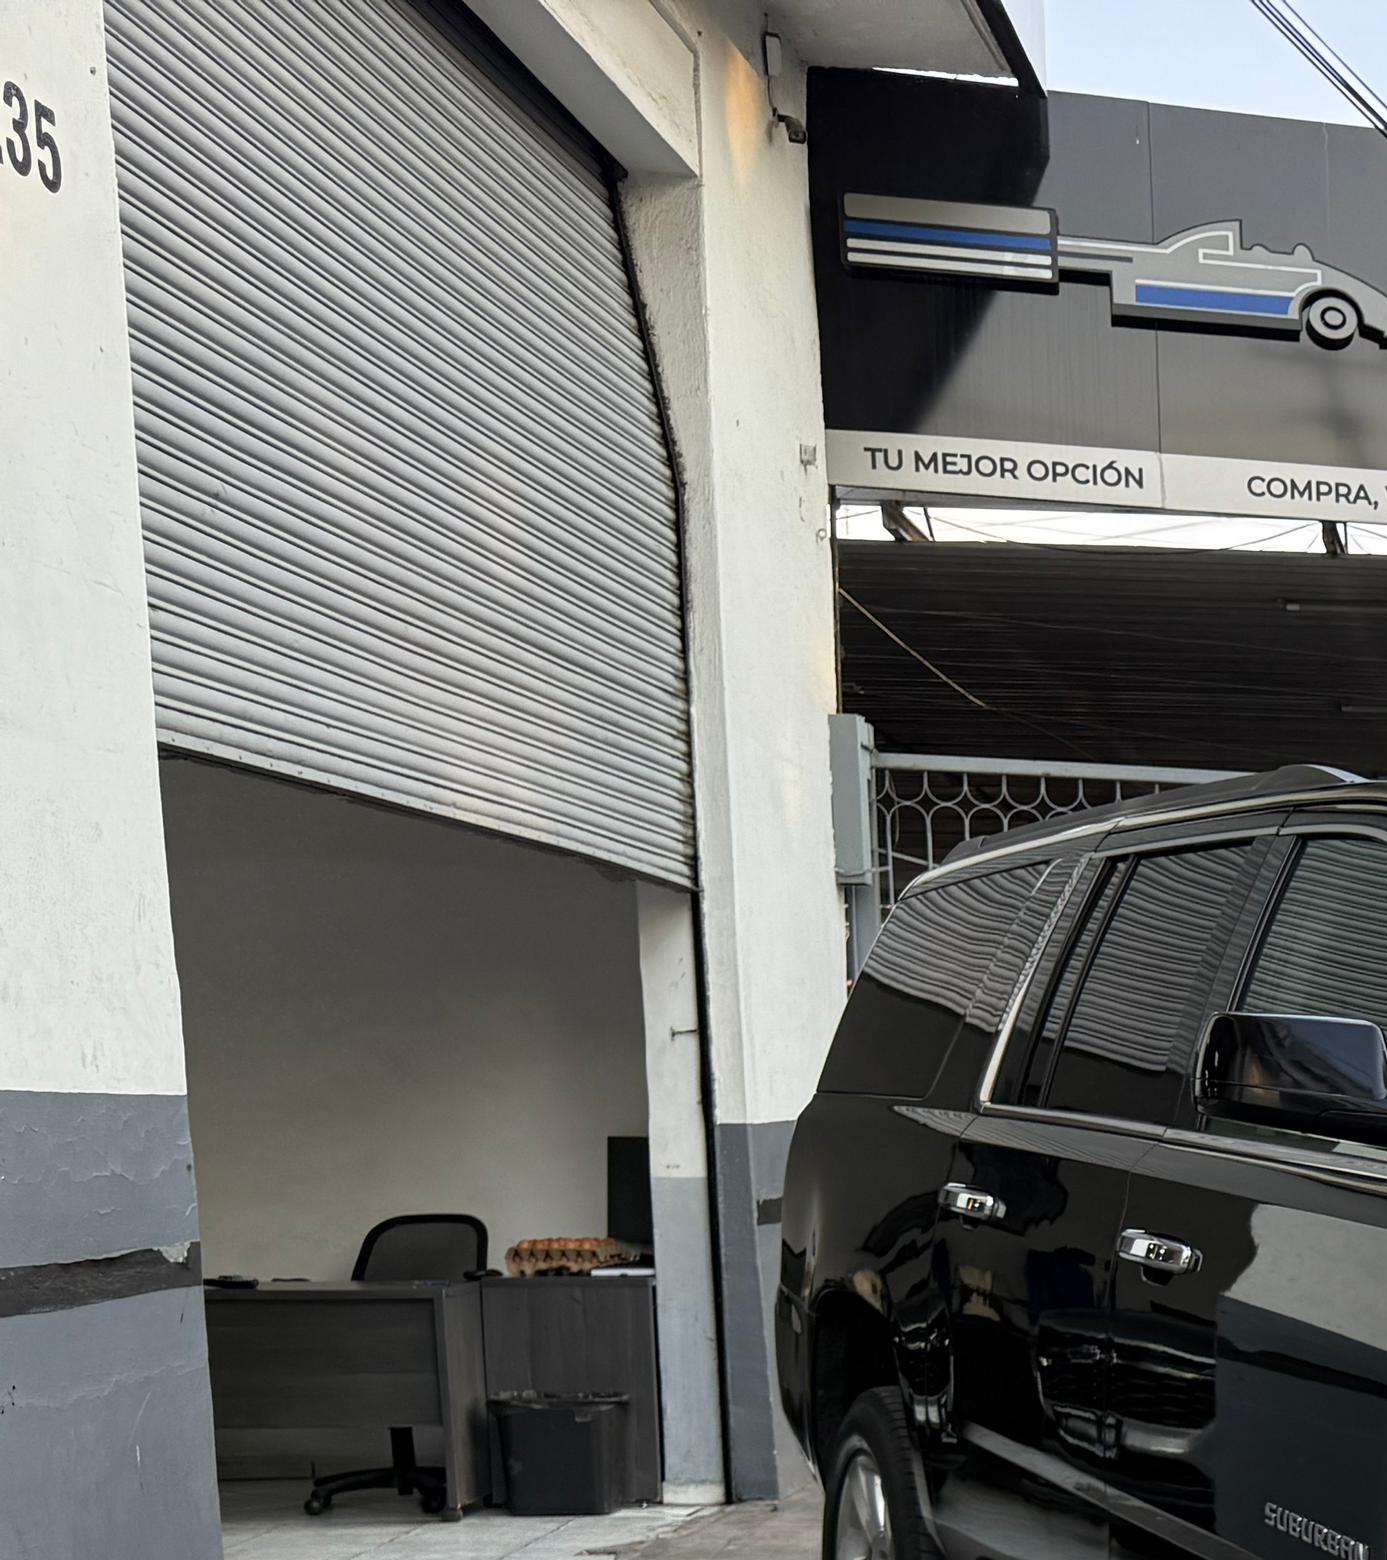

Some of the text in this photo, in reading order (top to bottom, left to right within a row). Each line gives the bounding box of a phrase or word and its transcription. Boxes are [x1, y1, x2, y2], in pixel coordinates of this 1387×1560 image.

[0, 81, 62, 193] 35
[864, 447, 1144, 489] TU MEJOR OPCIÓN
[1247, 475, 1380, 511] COMPRA,
